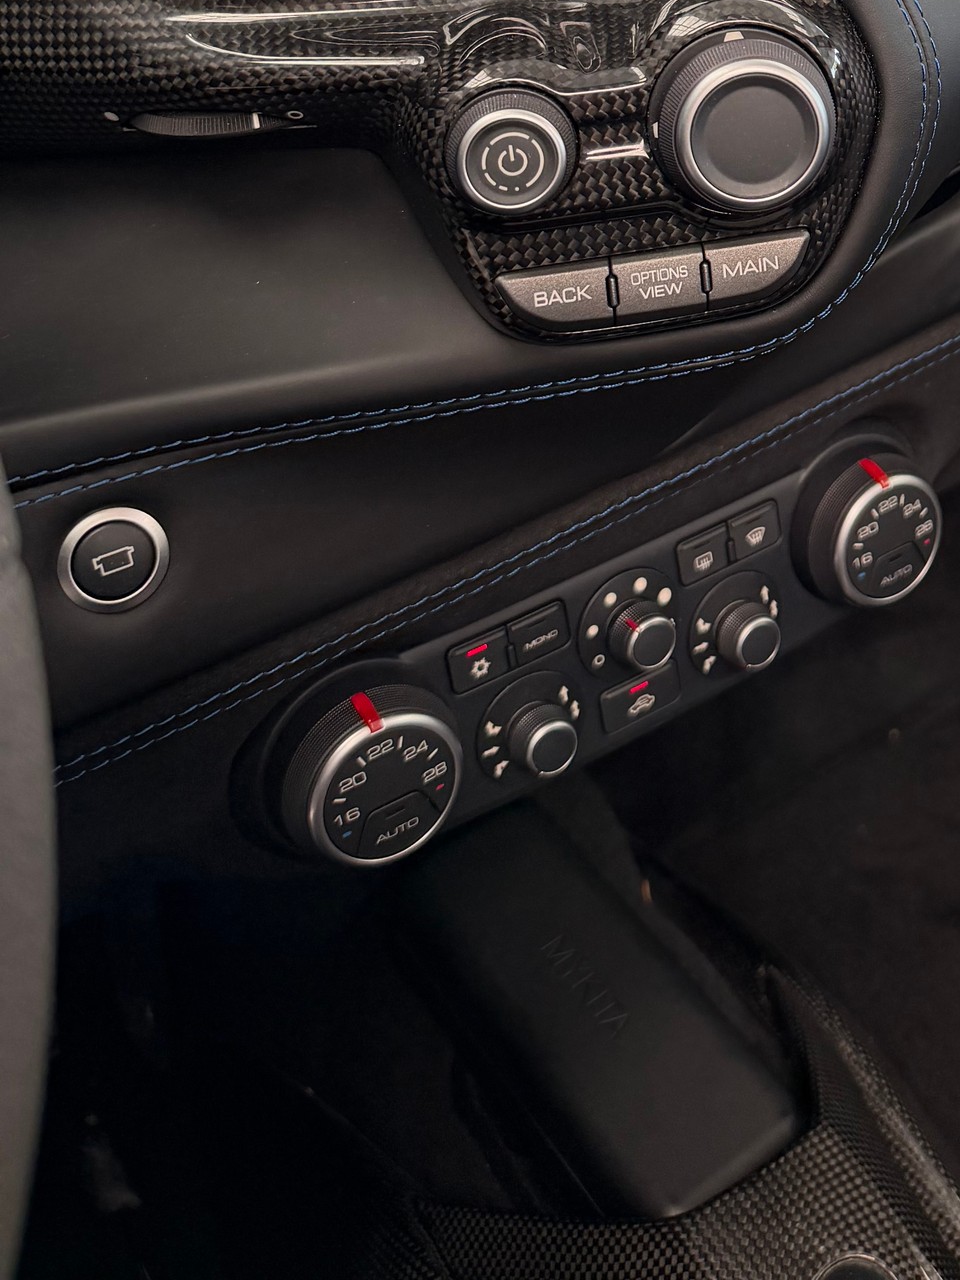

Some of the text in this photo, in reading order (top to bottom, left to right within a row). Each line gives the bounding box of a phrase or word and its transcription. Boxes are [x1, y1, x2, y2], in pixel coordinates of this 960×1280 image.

[631, 266, 688, 286] OPTIONS
[723, 256, 779, 278] MAIN
[533, 285, 592, 307] BACK
[639, 282, 683, 299] VIEW
[878, 495, 898, 514] 22
[903, 499, 921, 518] 24
[857, 521, 879, 540] 20
[915, 519, 933, 539] 28
[852, 552, 873, 569] 16
[881, 565, 912, 586] AUTO
[523, 629, 558, 652] MONO
[366, 738, 395, 761] 22
[403, 740, 429, 762] 24
[339, 771, 367, 793] 20
[422, 761, 448, 783] 28
[334, 807, 361, 826] 16
[376, 816, 419, 845] AUTO
